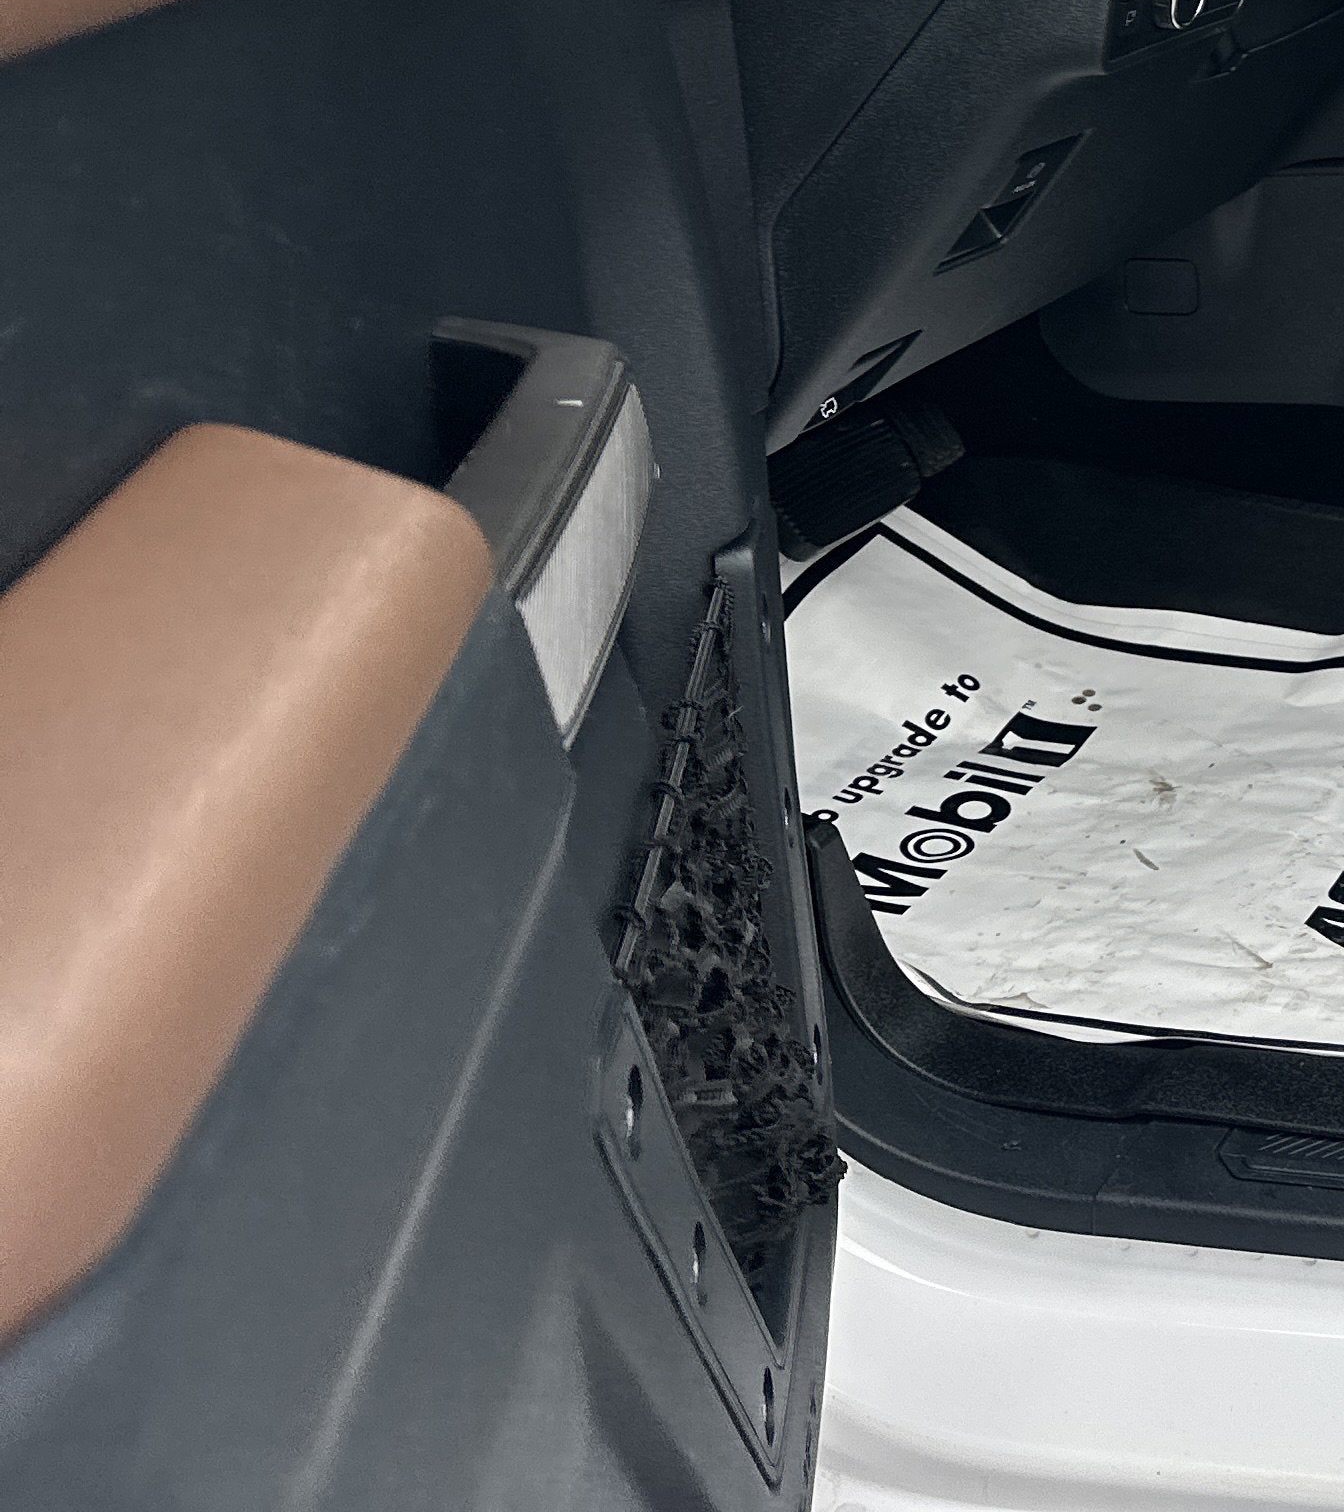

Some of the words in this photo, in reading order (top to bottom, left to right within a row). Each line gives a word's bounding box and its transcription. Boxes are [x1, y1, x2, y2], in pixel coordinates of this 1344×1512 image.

[831, 708, 952, 805] upgrade
[940, 673, 981, 703] to
[850, 760, 1047, 916] Mobil
